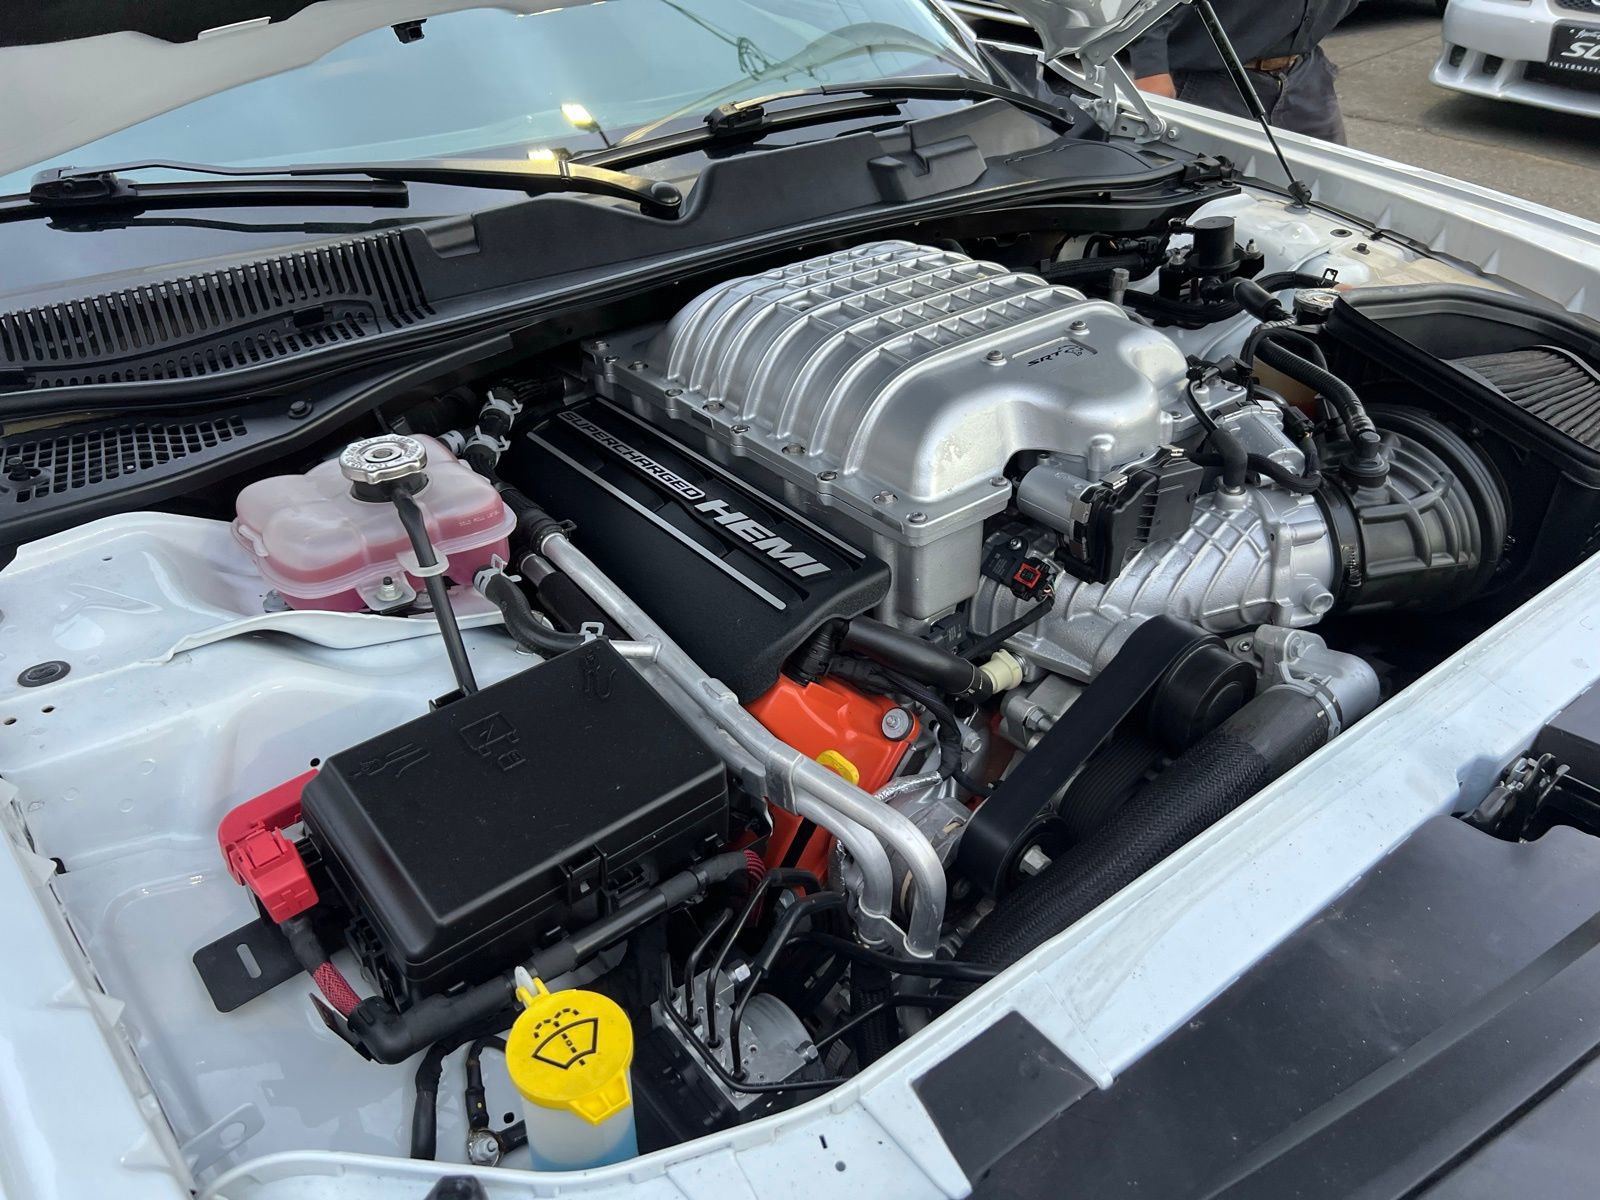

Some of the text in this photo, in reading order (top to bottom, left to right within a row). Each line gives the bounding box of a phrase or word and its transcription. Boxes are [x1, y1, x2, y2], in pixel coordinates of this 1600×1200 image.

[1028, 350, 1061, 367] SRT
[562, 412, 831, 577] SUPERCHARGED HEMI
